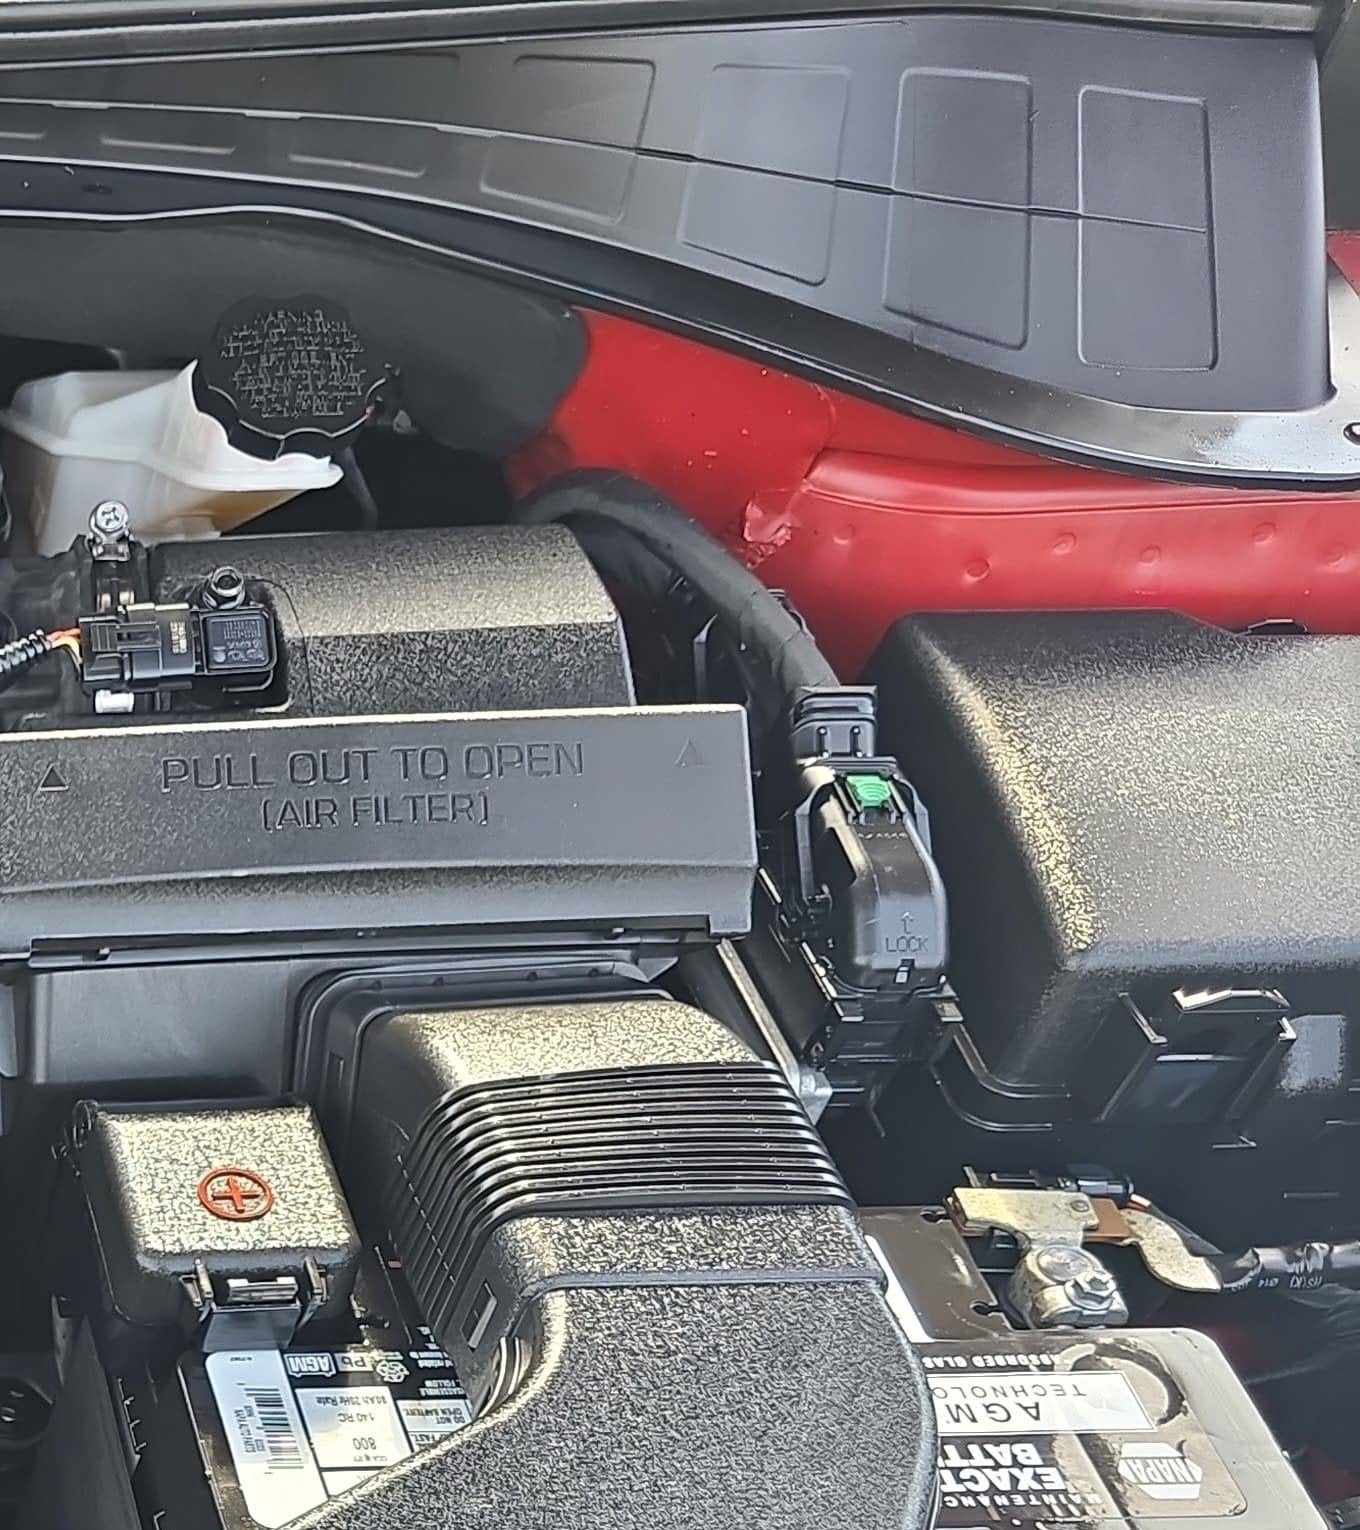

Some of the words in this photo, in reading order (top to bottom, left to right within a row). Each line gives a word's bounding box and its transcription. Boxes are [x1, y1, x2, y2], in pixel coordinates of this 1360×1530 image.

[161, 753, 275, 794] PULL
[288, 748, 378, 787] OUT
[390, 744, 450, 782] TO
[462, 741, 587, 780] OPEN
[885, 935, 929, 953] LOCK
[286, 1355, 330, 1373] AGM
[340, 1356, 367, 1369] Pb
[945, 1401, 1042, 1425] AGM
[352, 1437, 377, 1451] 800
[939, 1467, 1068, 1493] EXACT
[1130, 1458, 1192, 1484] NAPA
[941, 1493, 1104, 1509] MAINTENANC
